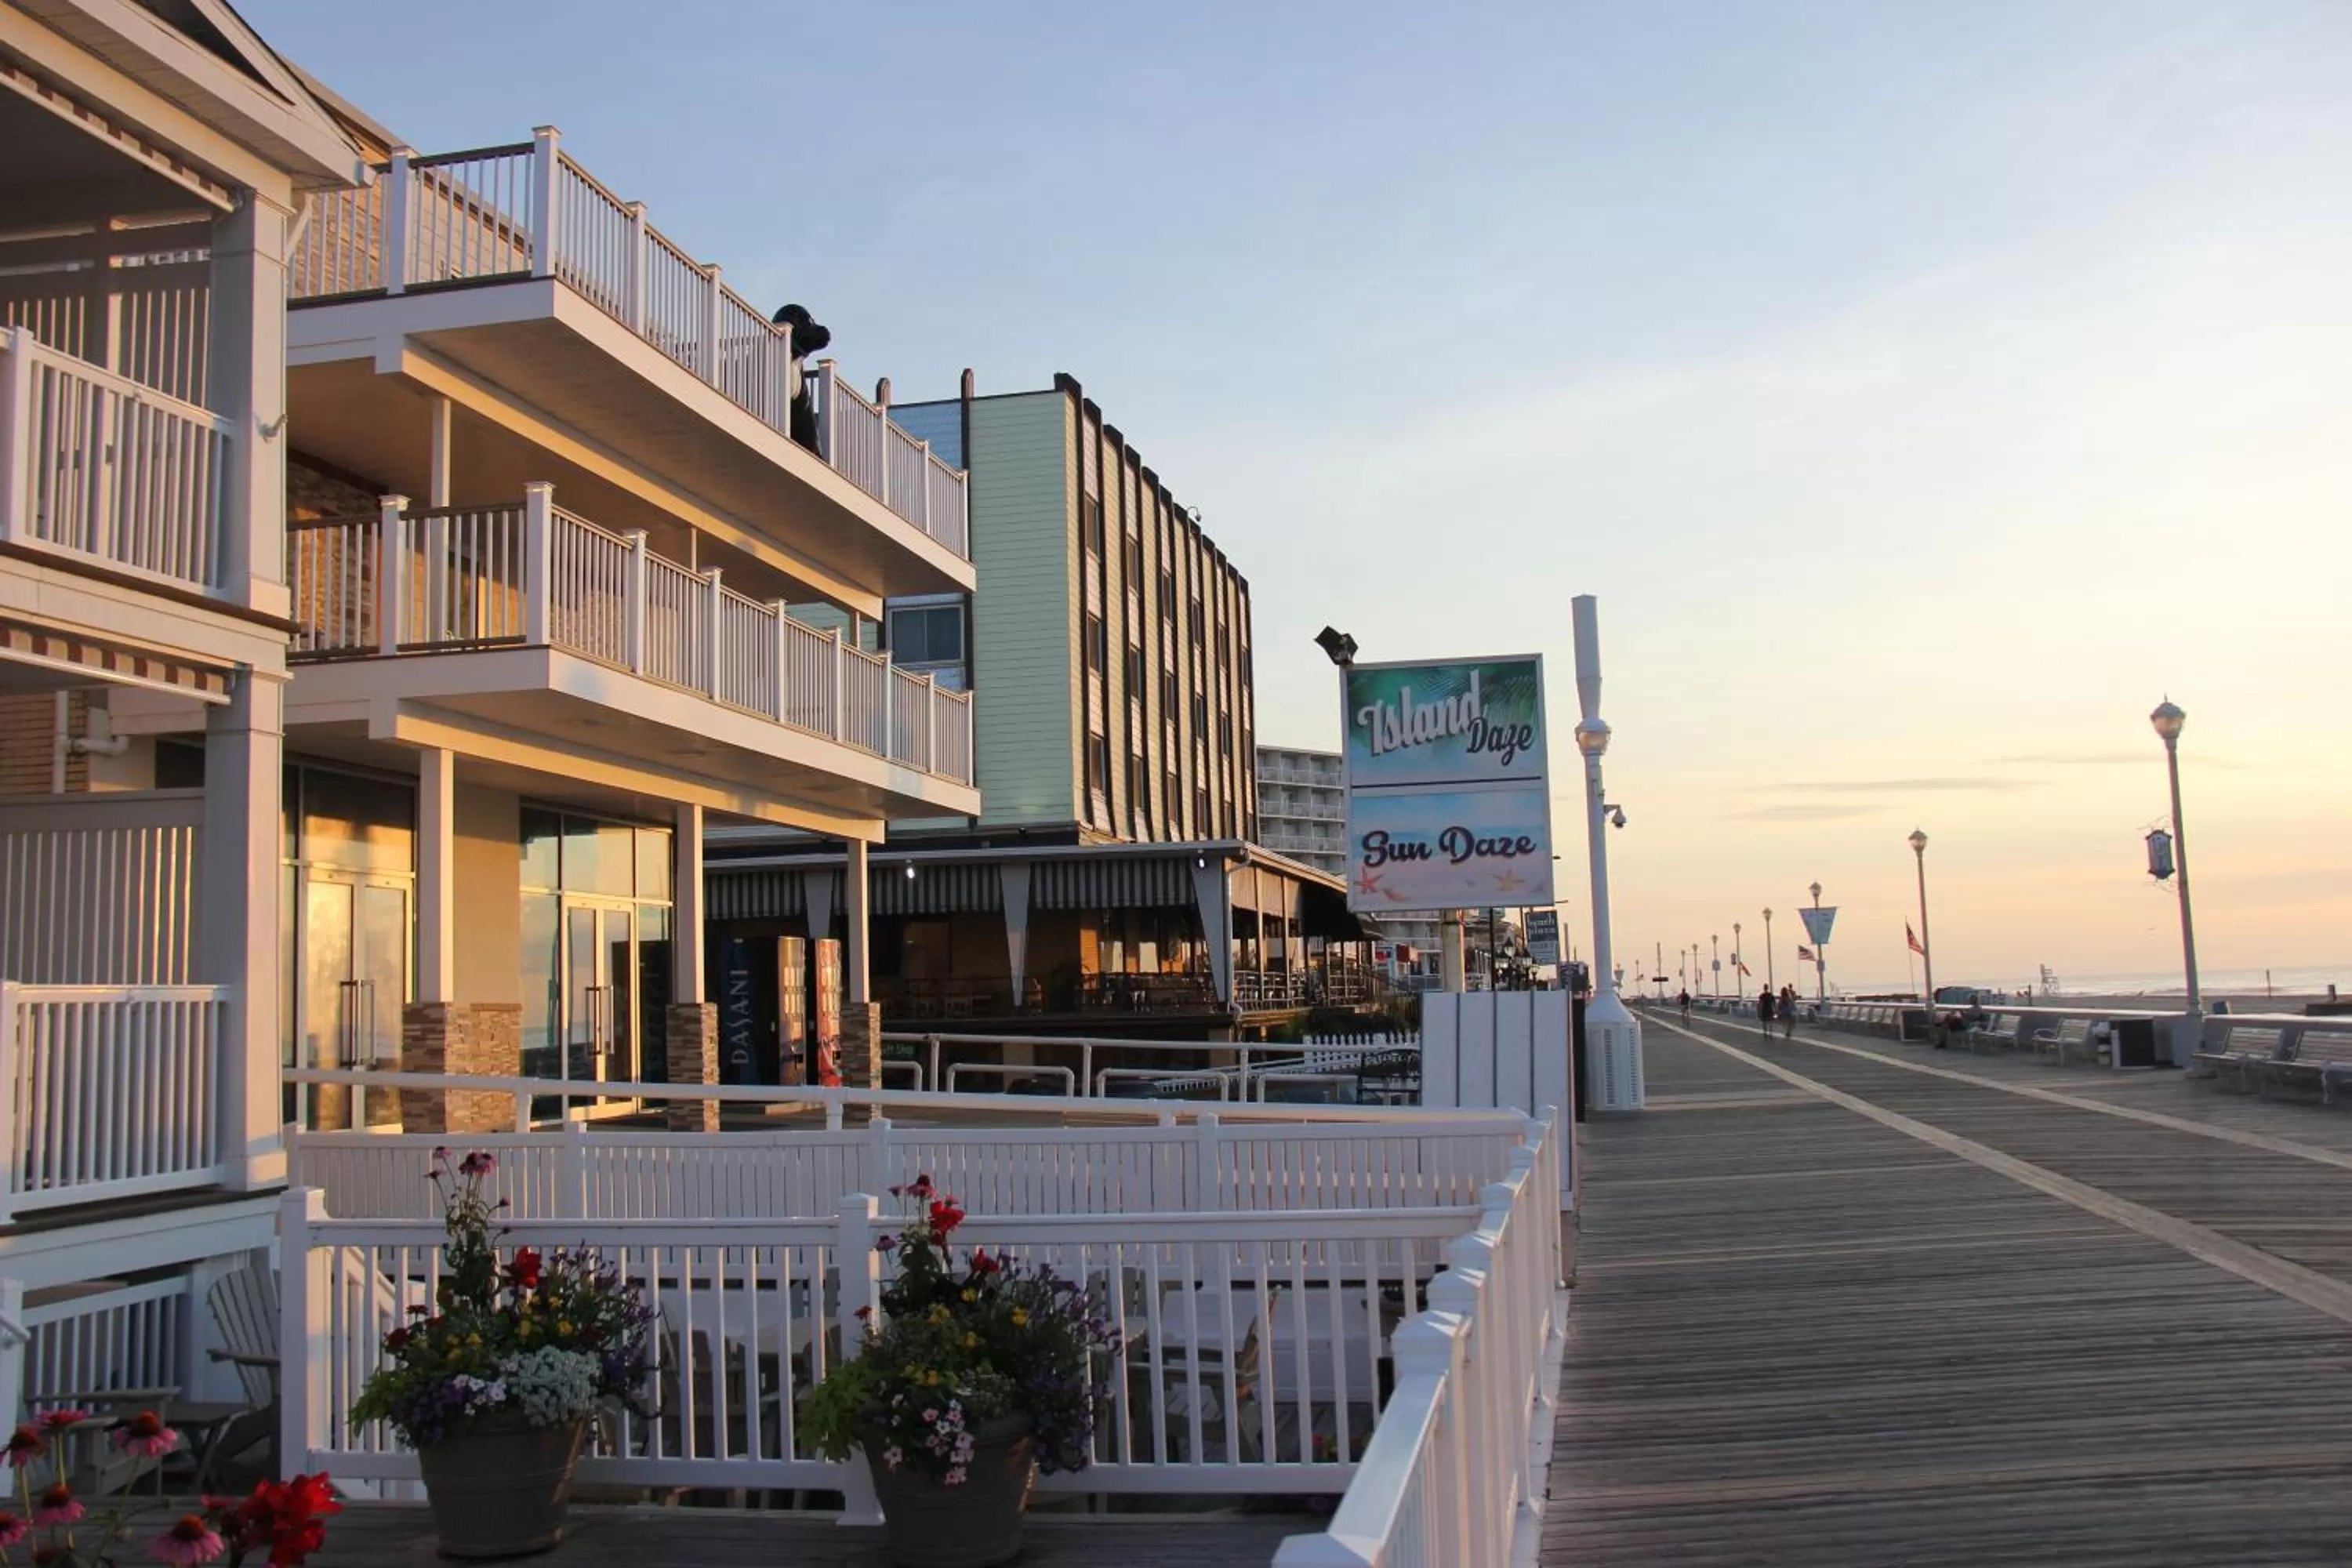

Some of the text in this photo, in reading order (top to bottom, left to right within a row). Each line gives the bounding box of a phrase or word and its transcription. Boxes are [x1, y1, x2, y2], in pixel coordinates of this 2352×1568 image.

[1358, 670, 1534, 766] Island Daze
[1362, 826, 1537, 868] Sun Daze
[729, 970, 753, 1064] DASANI
